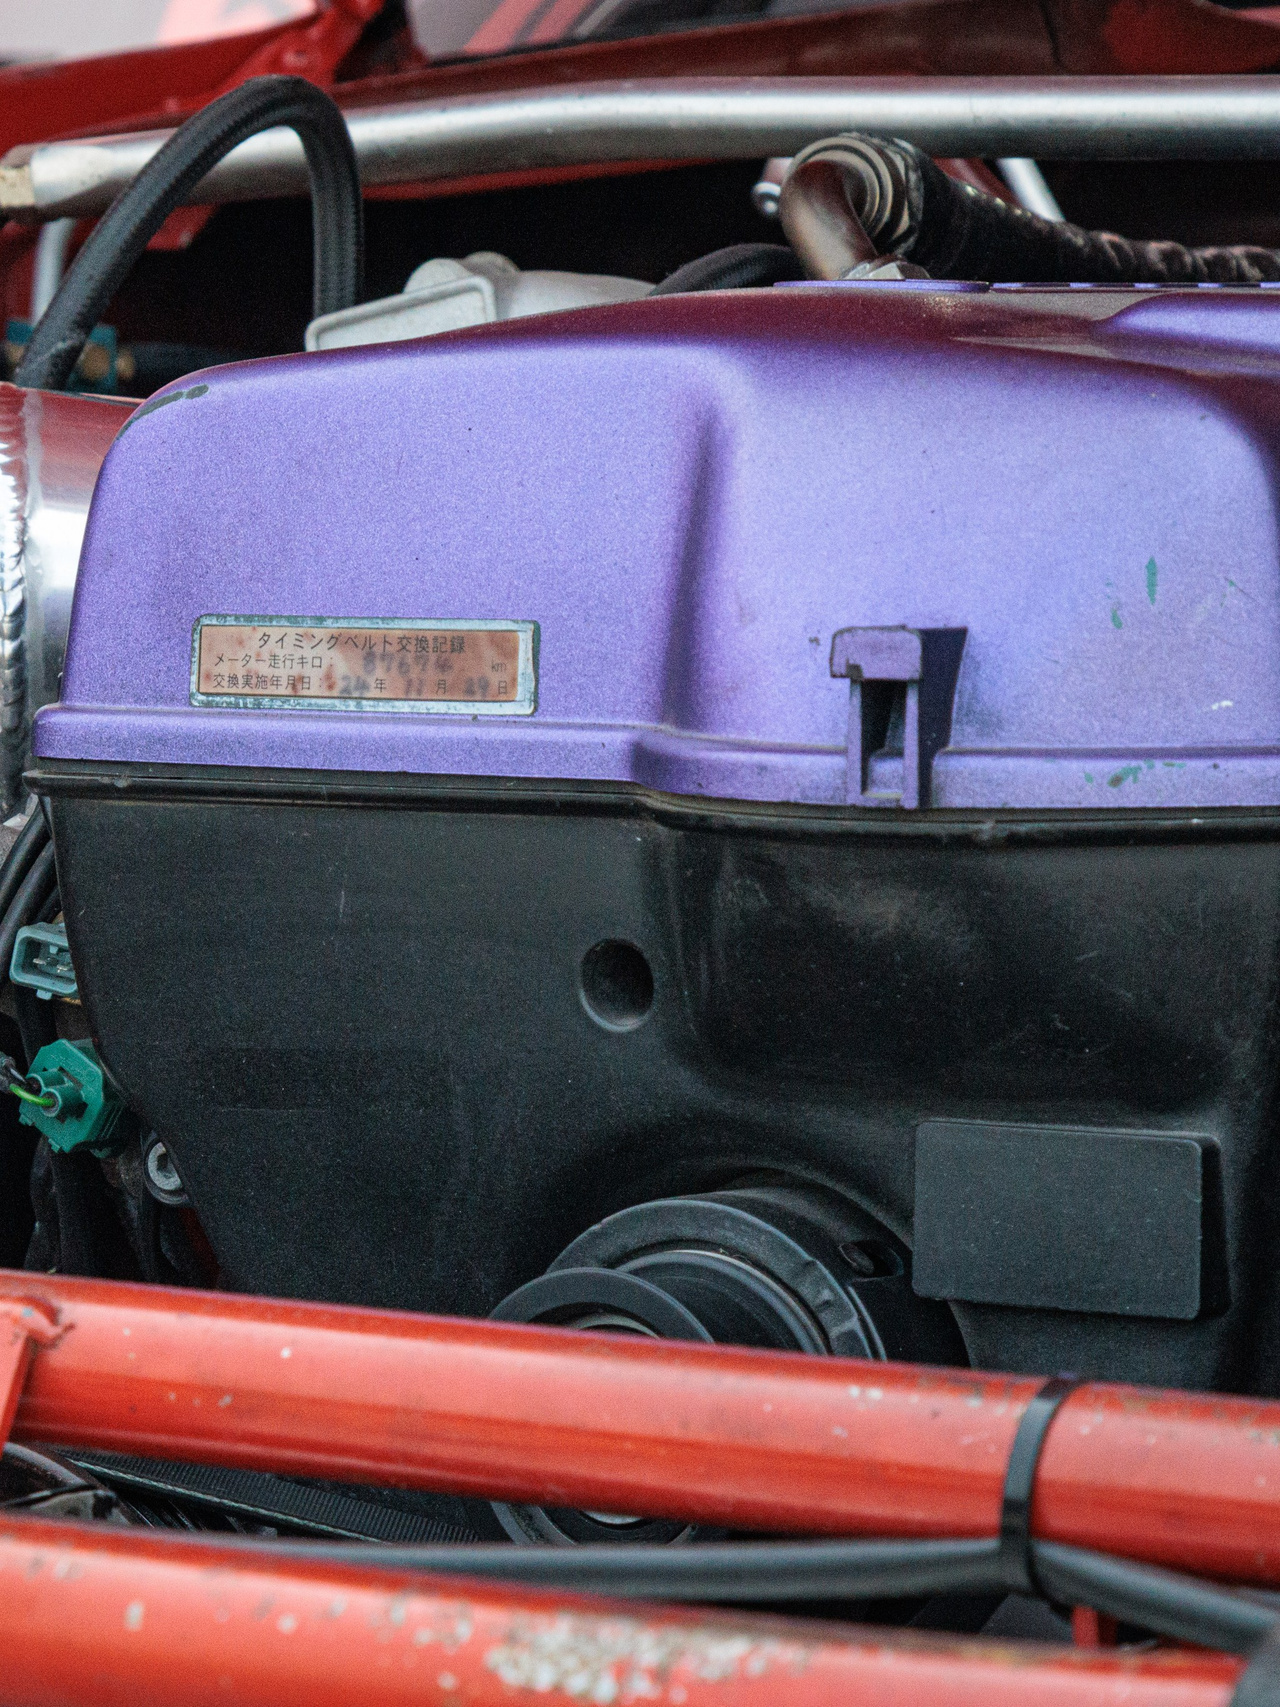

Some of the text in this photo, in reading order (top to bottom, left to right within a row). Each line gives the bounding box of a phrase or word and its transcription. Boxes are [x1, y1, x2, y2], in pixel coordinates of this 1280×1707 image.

[258, 631, 466, 654] タイミングベルト交換記録
[491, 660, 507, 673] km
[373, 678, 387, 693] 年
[435, 679, 447, 694] 月
[497, 681, 508, 695] 日
